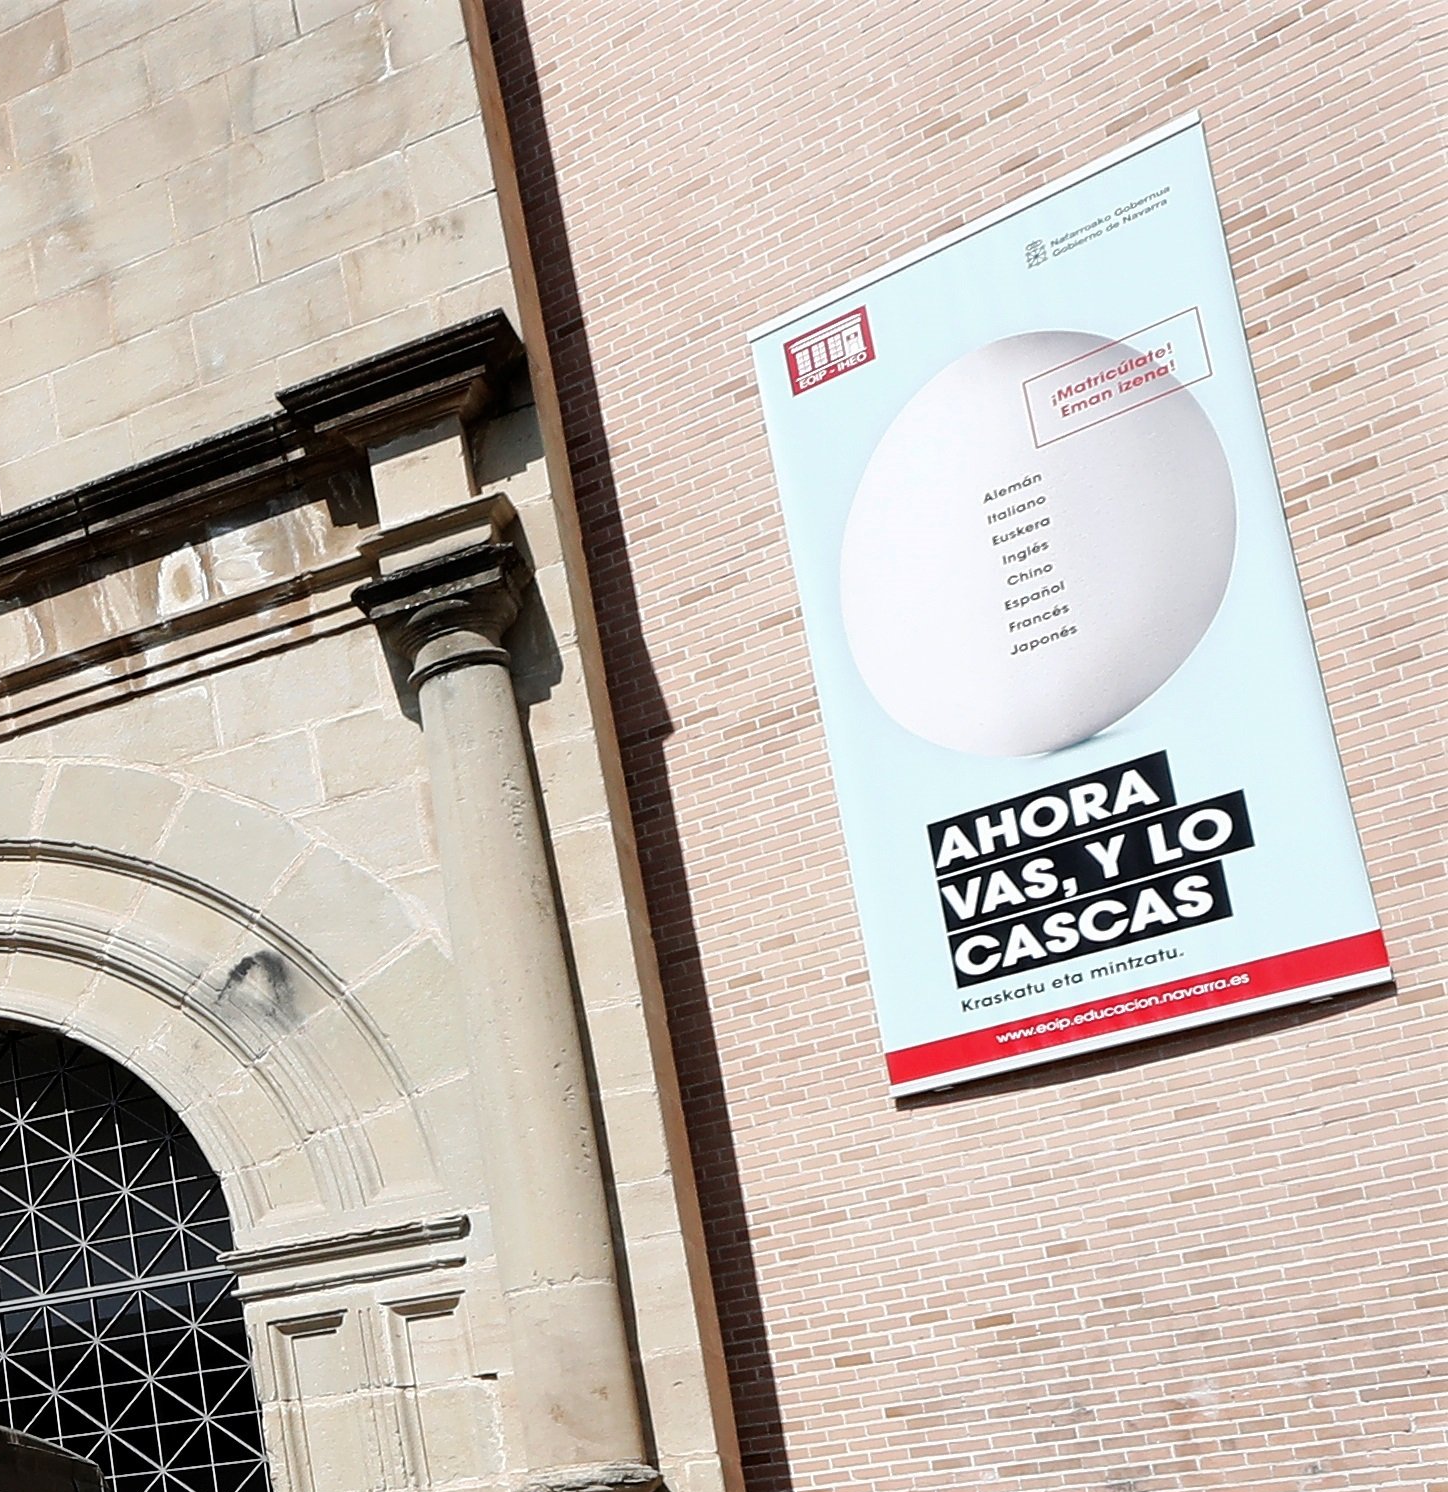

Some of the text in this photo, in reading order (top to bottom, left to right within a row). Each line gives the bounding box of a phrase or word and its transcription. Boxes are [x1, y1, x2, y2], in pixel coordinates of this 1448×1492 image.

[1114, 186, 1170, 217] Gobernua
[1052, 198, 1168, 257] Gobierno de Navarra
[799, 370, 827, 390] EOIP
[1051, 342, 1173, 407] ¡Matricúlate!
[1060, 359, 1176, 418] Eman izena!
[983, 473, 1042, 504] Alemán
[987, 496, 1046, 525] Italiano
[992, 517, 1051, 546] Euskera
[1002, 541, 1049, 565] Inglés
[1006, 563, 1053, 586] Chino
[1004, 580, 1065, 611] Español
[1009, 604, 1070, 633] Francés
[1010, 625, 1078, 655] Japonés
[936, 768, 1160, 869] AHORA
[941, 808, 1233, 921] VAS, Y LO
[954, 875, 1214, 976] CASCAS
[961, 947, 1185, 1013] Kraskatu eta mintzatu.
[995, 972, 1251, 1044] www.eoip.educacion.navarra.es
